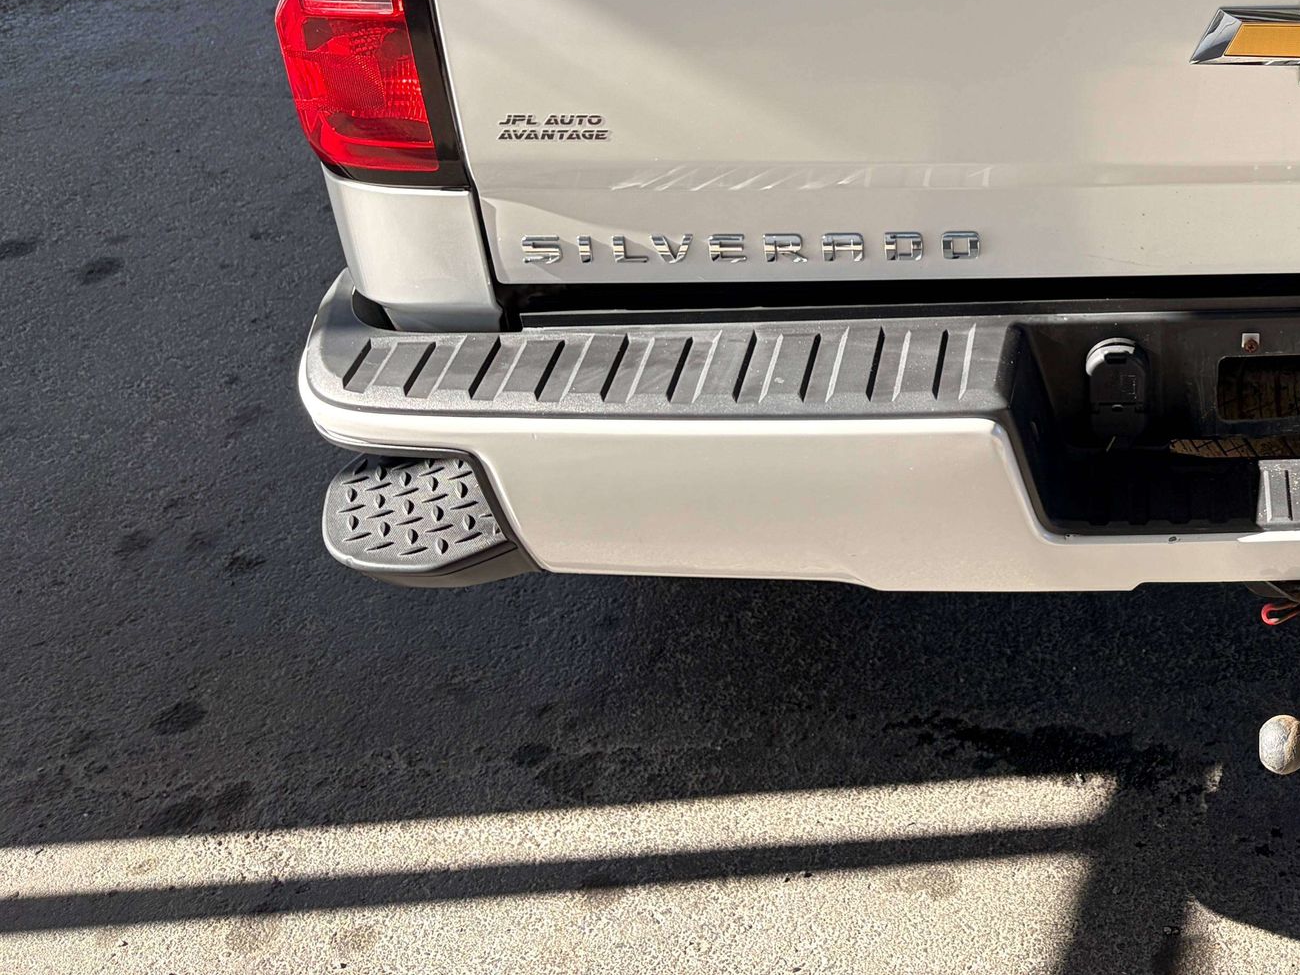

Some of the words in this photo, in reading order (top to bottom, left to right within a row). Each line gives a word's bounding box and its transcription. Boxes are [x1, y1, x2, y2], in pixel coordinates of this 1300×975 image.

[499, 114, 538, 126] JPL
[544, 114, 603, 126] AUTO
[498, 129, 609, 140] AVANTAGE
[520, 230, 982, 265] SILVERADO
